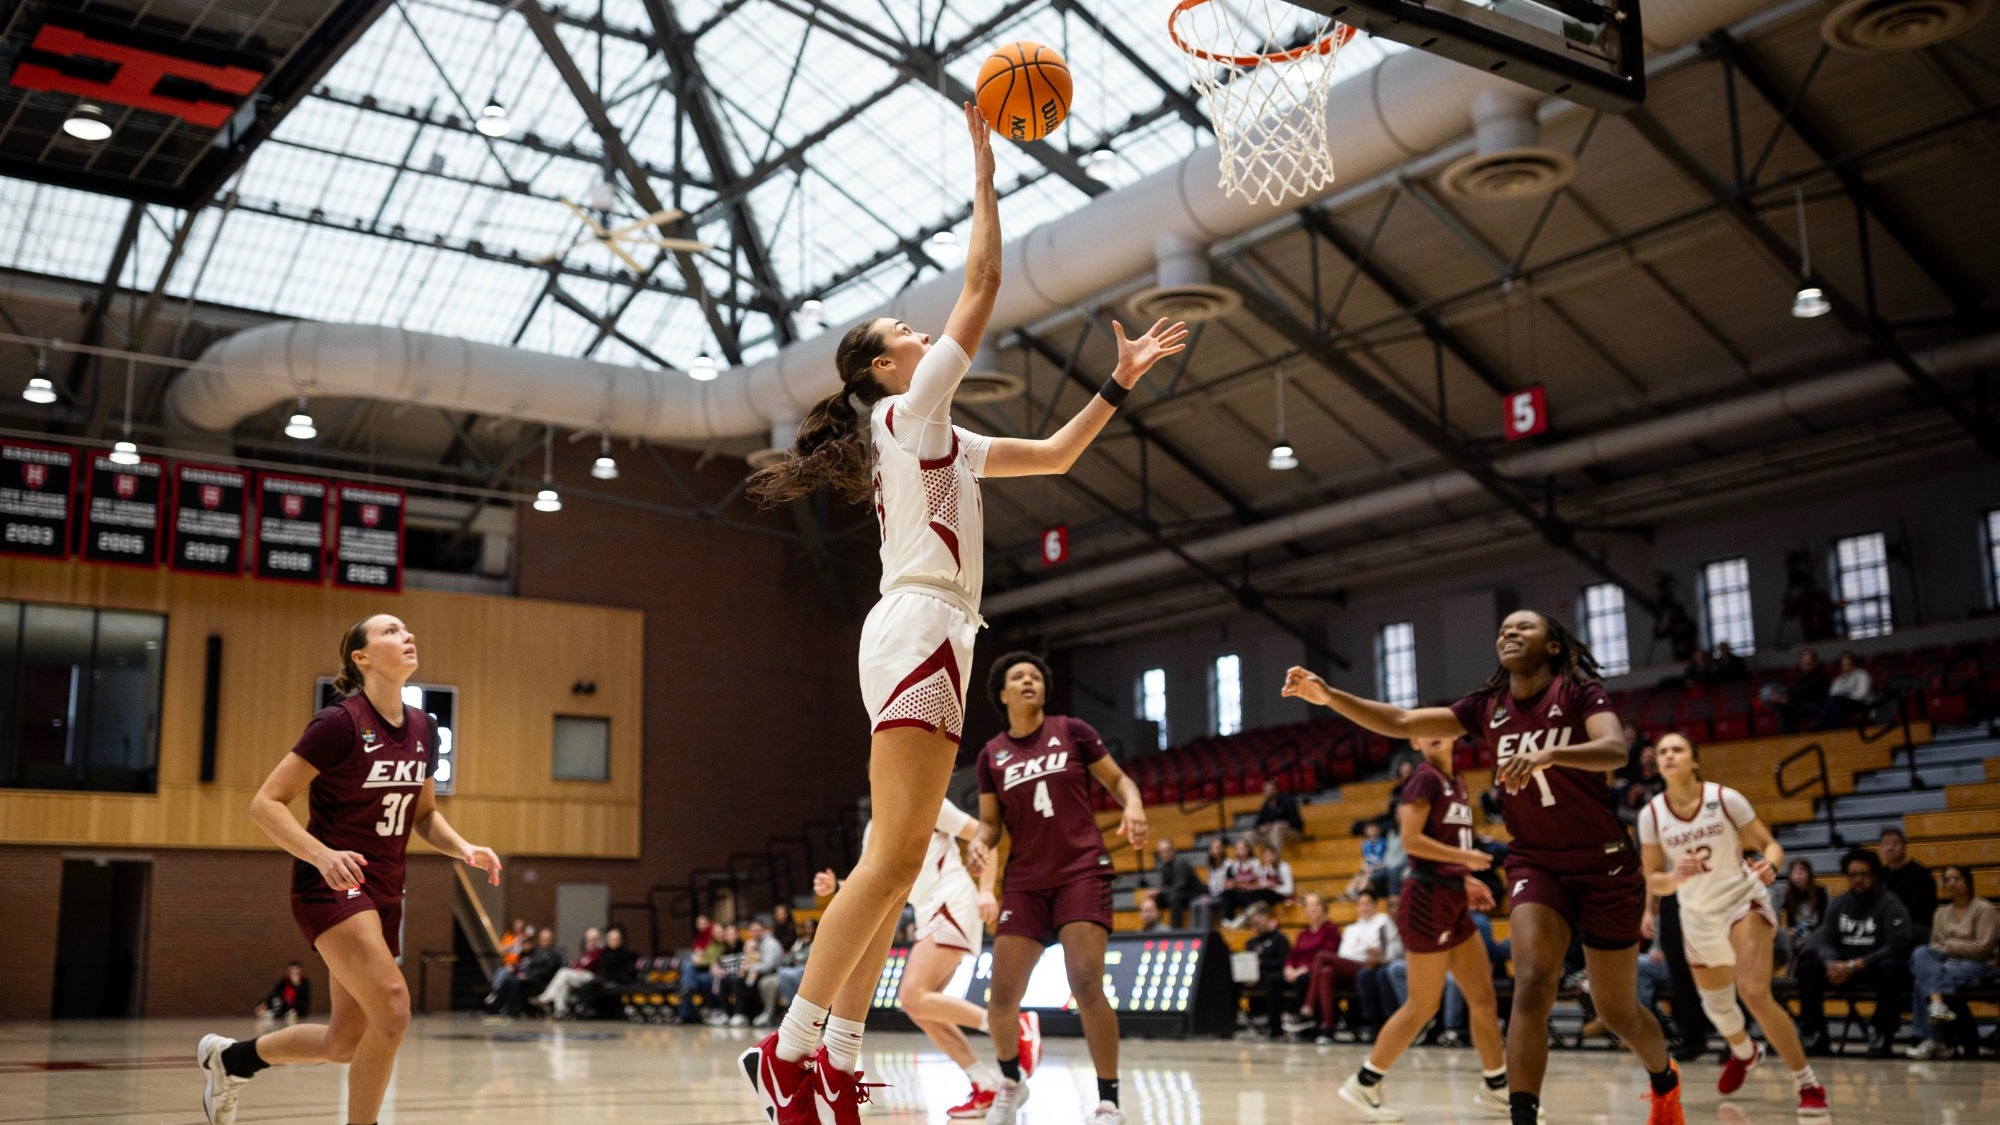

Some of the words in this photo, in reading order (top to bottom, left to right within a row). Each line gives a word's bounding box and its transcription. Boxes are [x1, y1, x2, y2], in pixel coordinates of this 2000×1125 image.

[1513, 392, 1536, 433] 5
[5, 523, 54, 546] 2003
[1045, 530, 1061, 562] 6
[185, 541, 230, 564] 2007
[346, 563, 388, 585] 2025
[1497, 727, 1572, 759] EKU
[366, 760, 427, 782] EKU
[1004, 752, 1068, 786] EKU
[1033, 780, 1054, 818] 4
[1446, 802, 1473, 821] EK
[375, 793, 414, 836] 31
[1686, 846, 1711, 872] 2
